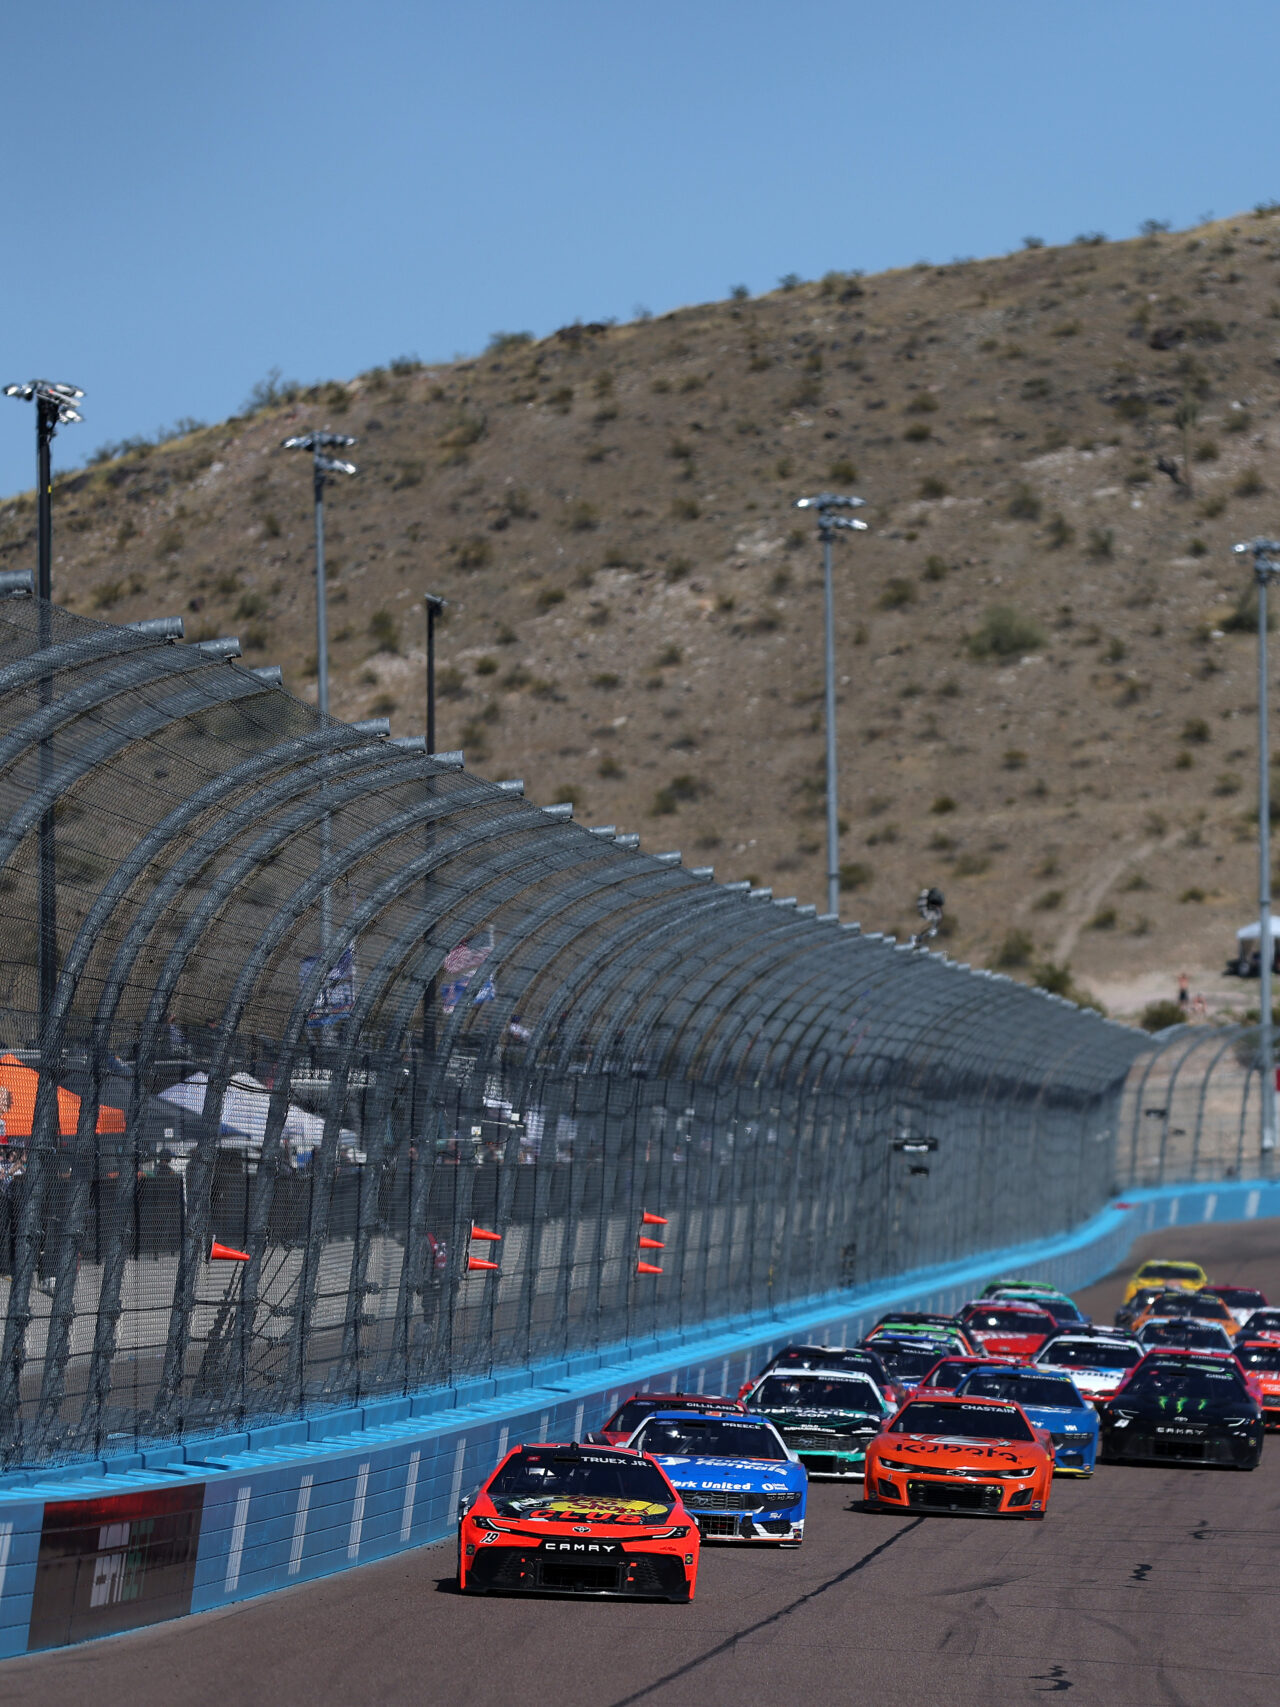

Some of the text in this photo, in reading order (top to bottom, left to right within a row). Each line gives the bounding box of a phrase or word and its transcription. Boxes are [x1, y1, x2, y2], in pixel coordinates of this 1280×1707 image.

[687, 1402, 736, 1411] GILLILAND
[961, 1404, 1015, 1414] CHASTAIN
[722, 1422, 761, 1430] PREECE
[1156, 1427, 1204, 1436] CAMRY
[581, 1456, 653, 1468] TRUEX JR.
[702, 1481, 751, 1490] United
[529, 1510, 642, 1523] CLUB
[480, 1532, 501, 1544] 19
[545, 1543, 616, 1552] CAMRY
